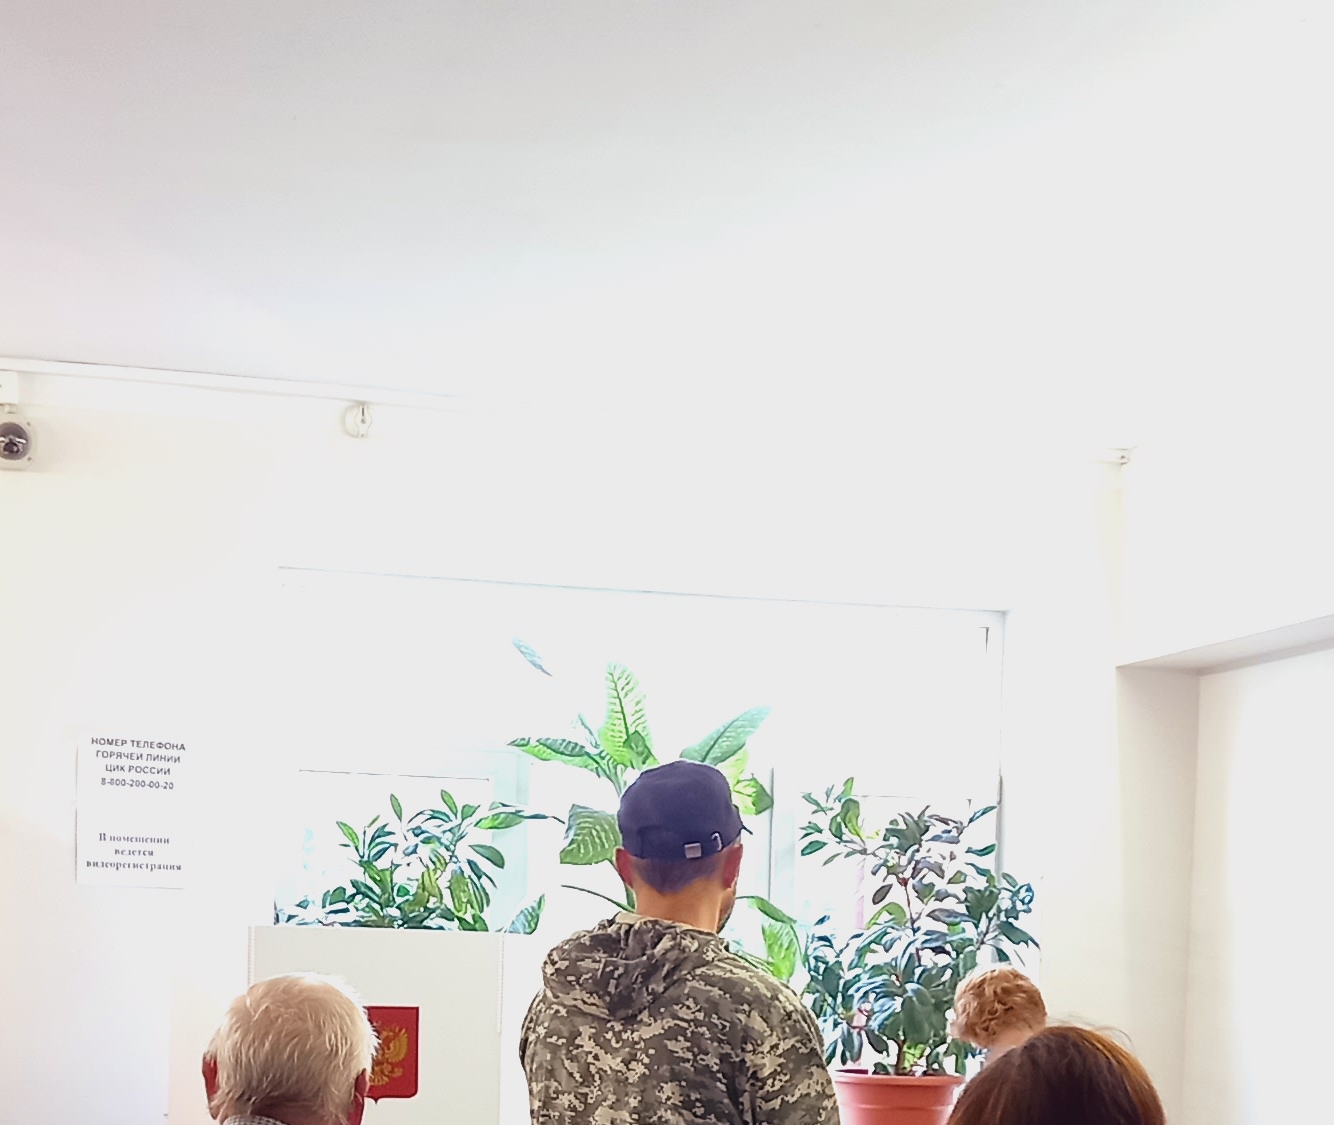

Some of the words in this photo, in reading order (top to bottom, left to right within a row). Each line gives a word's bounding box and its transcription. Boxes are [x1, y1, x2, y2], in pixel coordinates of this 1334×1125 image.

[91, 737, 127, 746] НОМЕР
[130, 739, 186, 751] ТЕЛЕФОНА
[146, 753, 180, 763] ЛИНИИ
[105, 764, 125, 772] ЦИК
[128, 765, 171, 775] РОССИИ
[101, 777, 174, 789] 8-800-200-00-20
[99, 833, 106, 841] В
